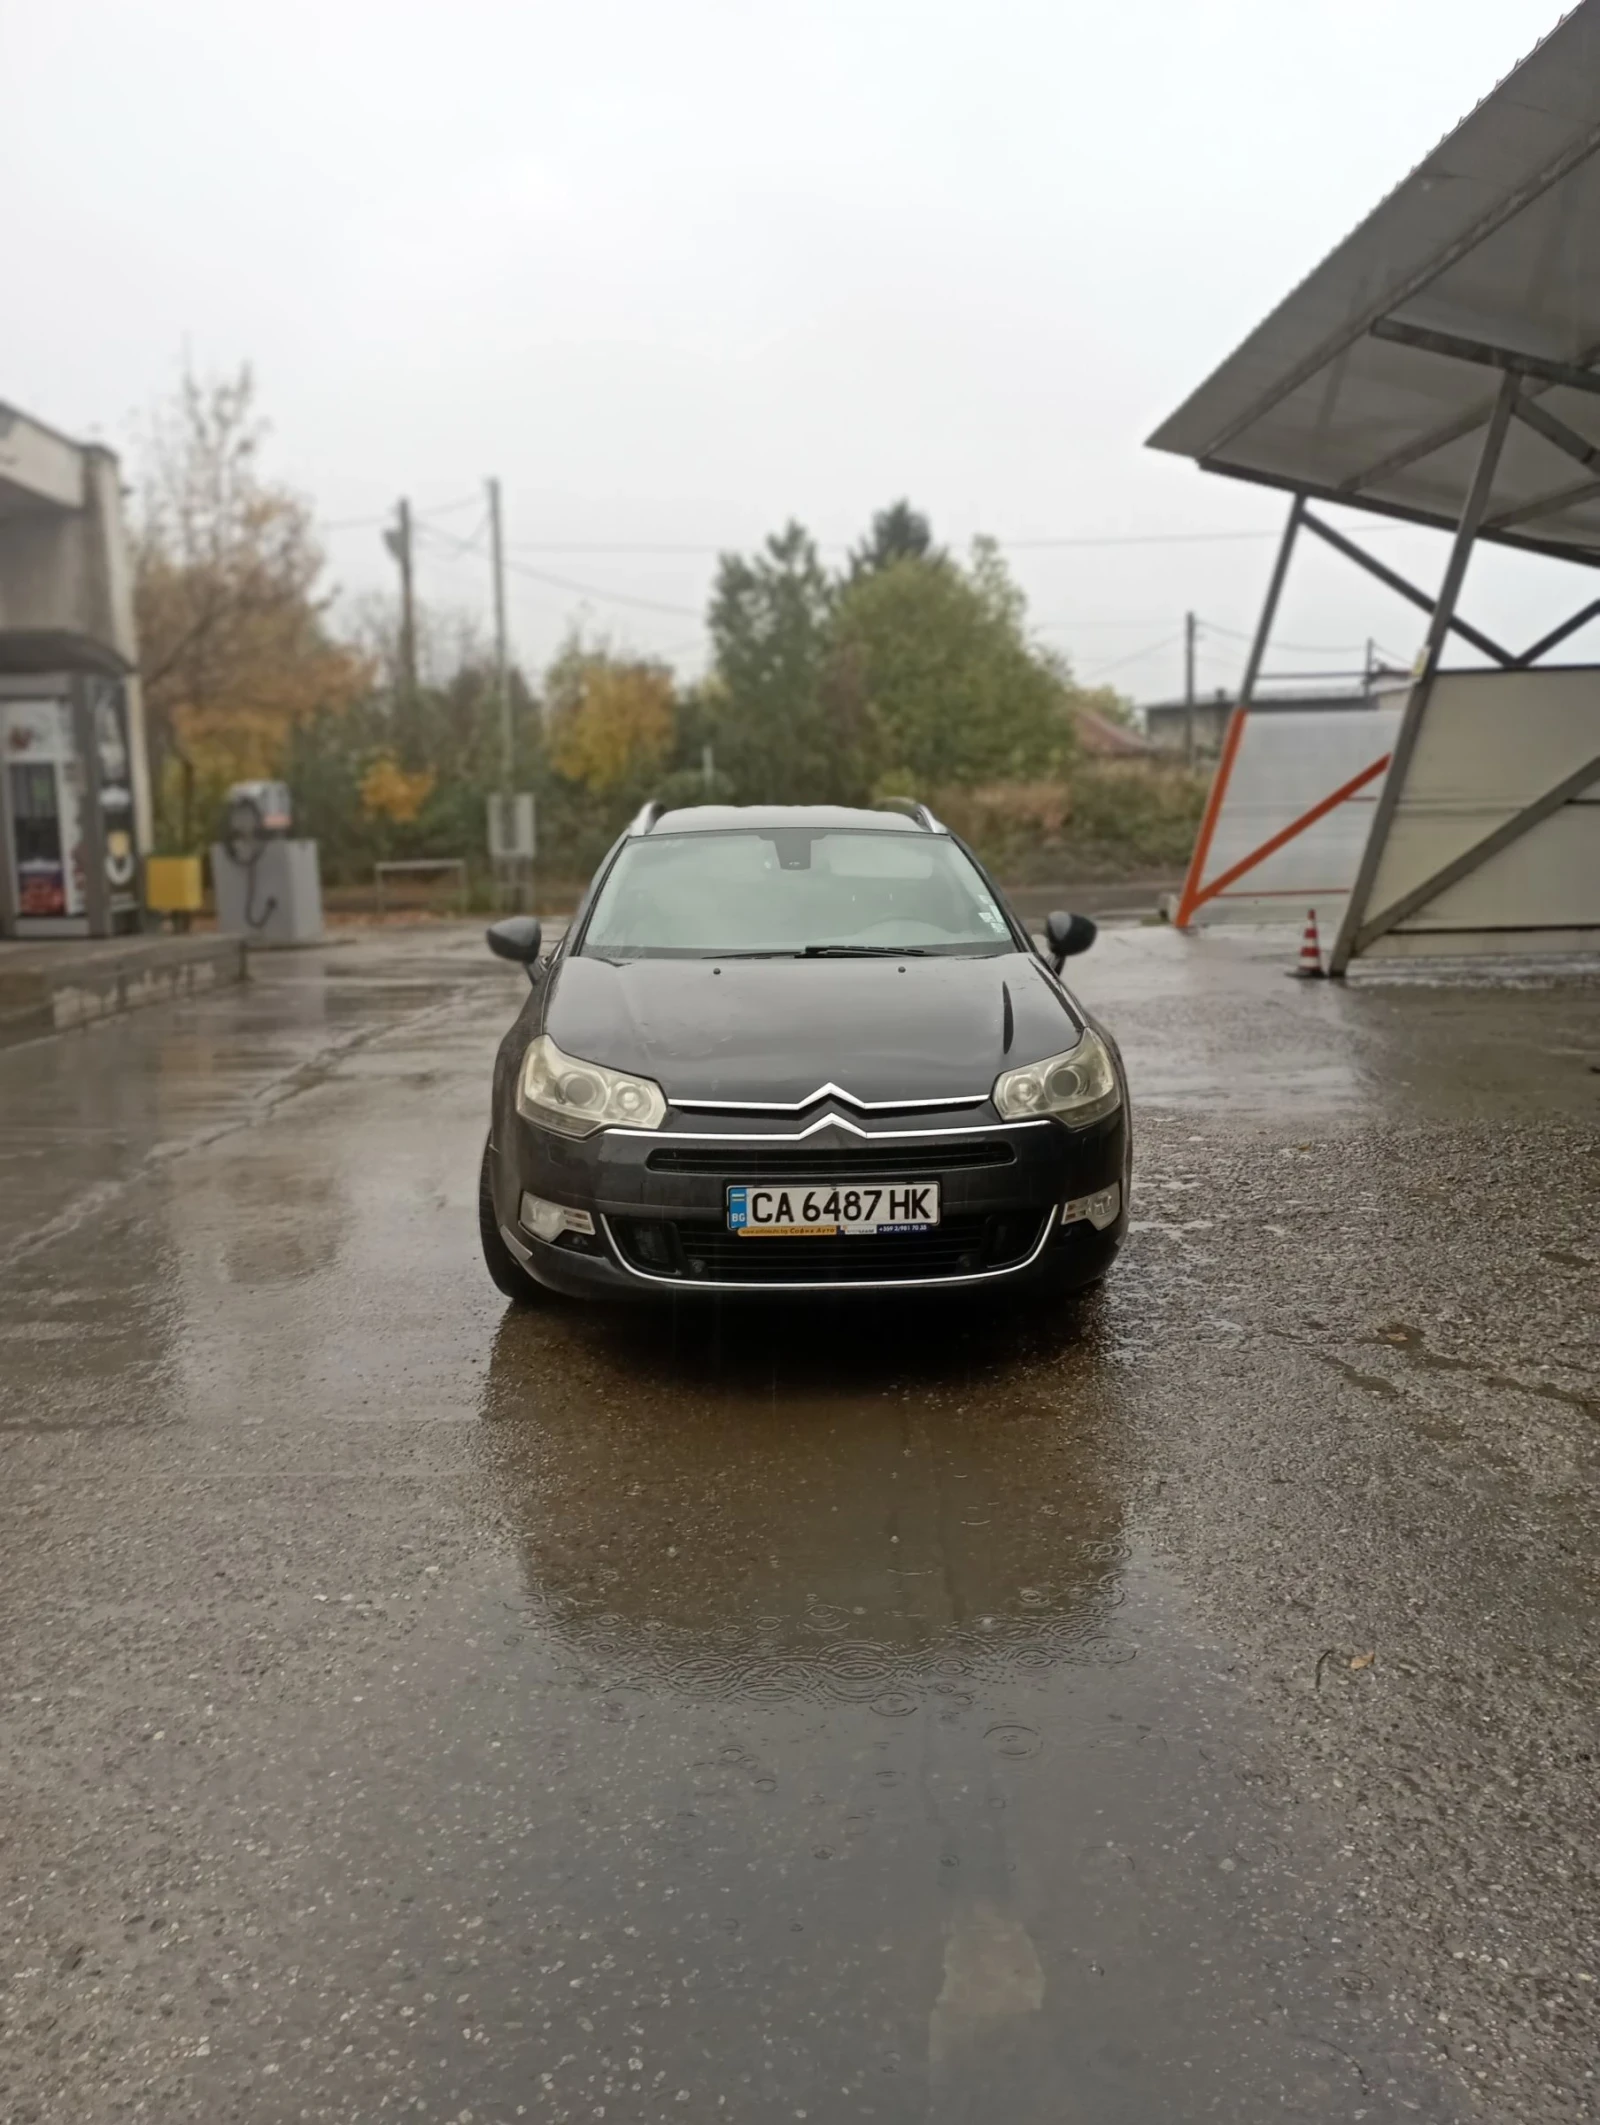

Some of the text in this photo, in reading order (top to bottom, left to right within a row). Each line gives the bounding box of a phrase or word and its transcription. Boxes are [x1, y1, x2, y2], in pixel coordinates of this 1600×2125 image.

[751, 1188, 931, 1223] CA 6487 HK
[731, 1213, 746, 1222] BG
